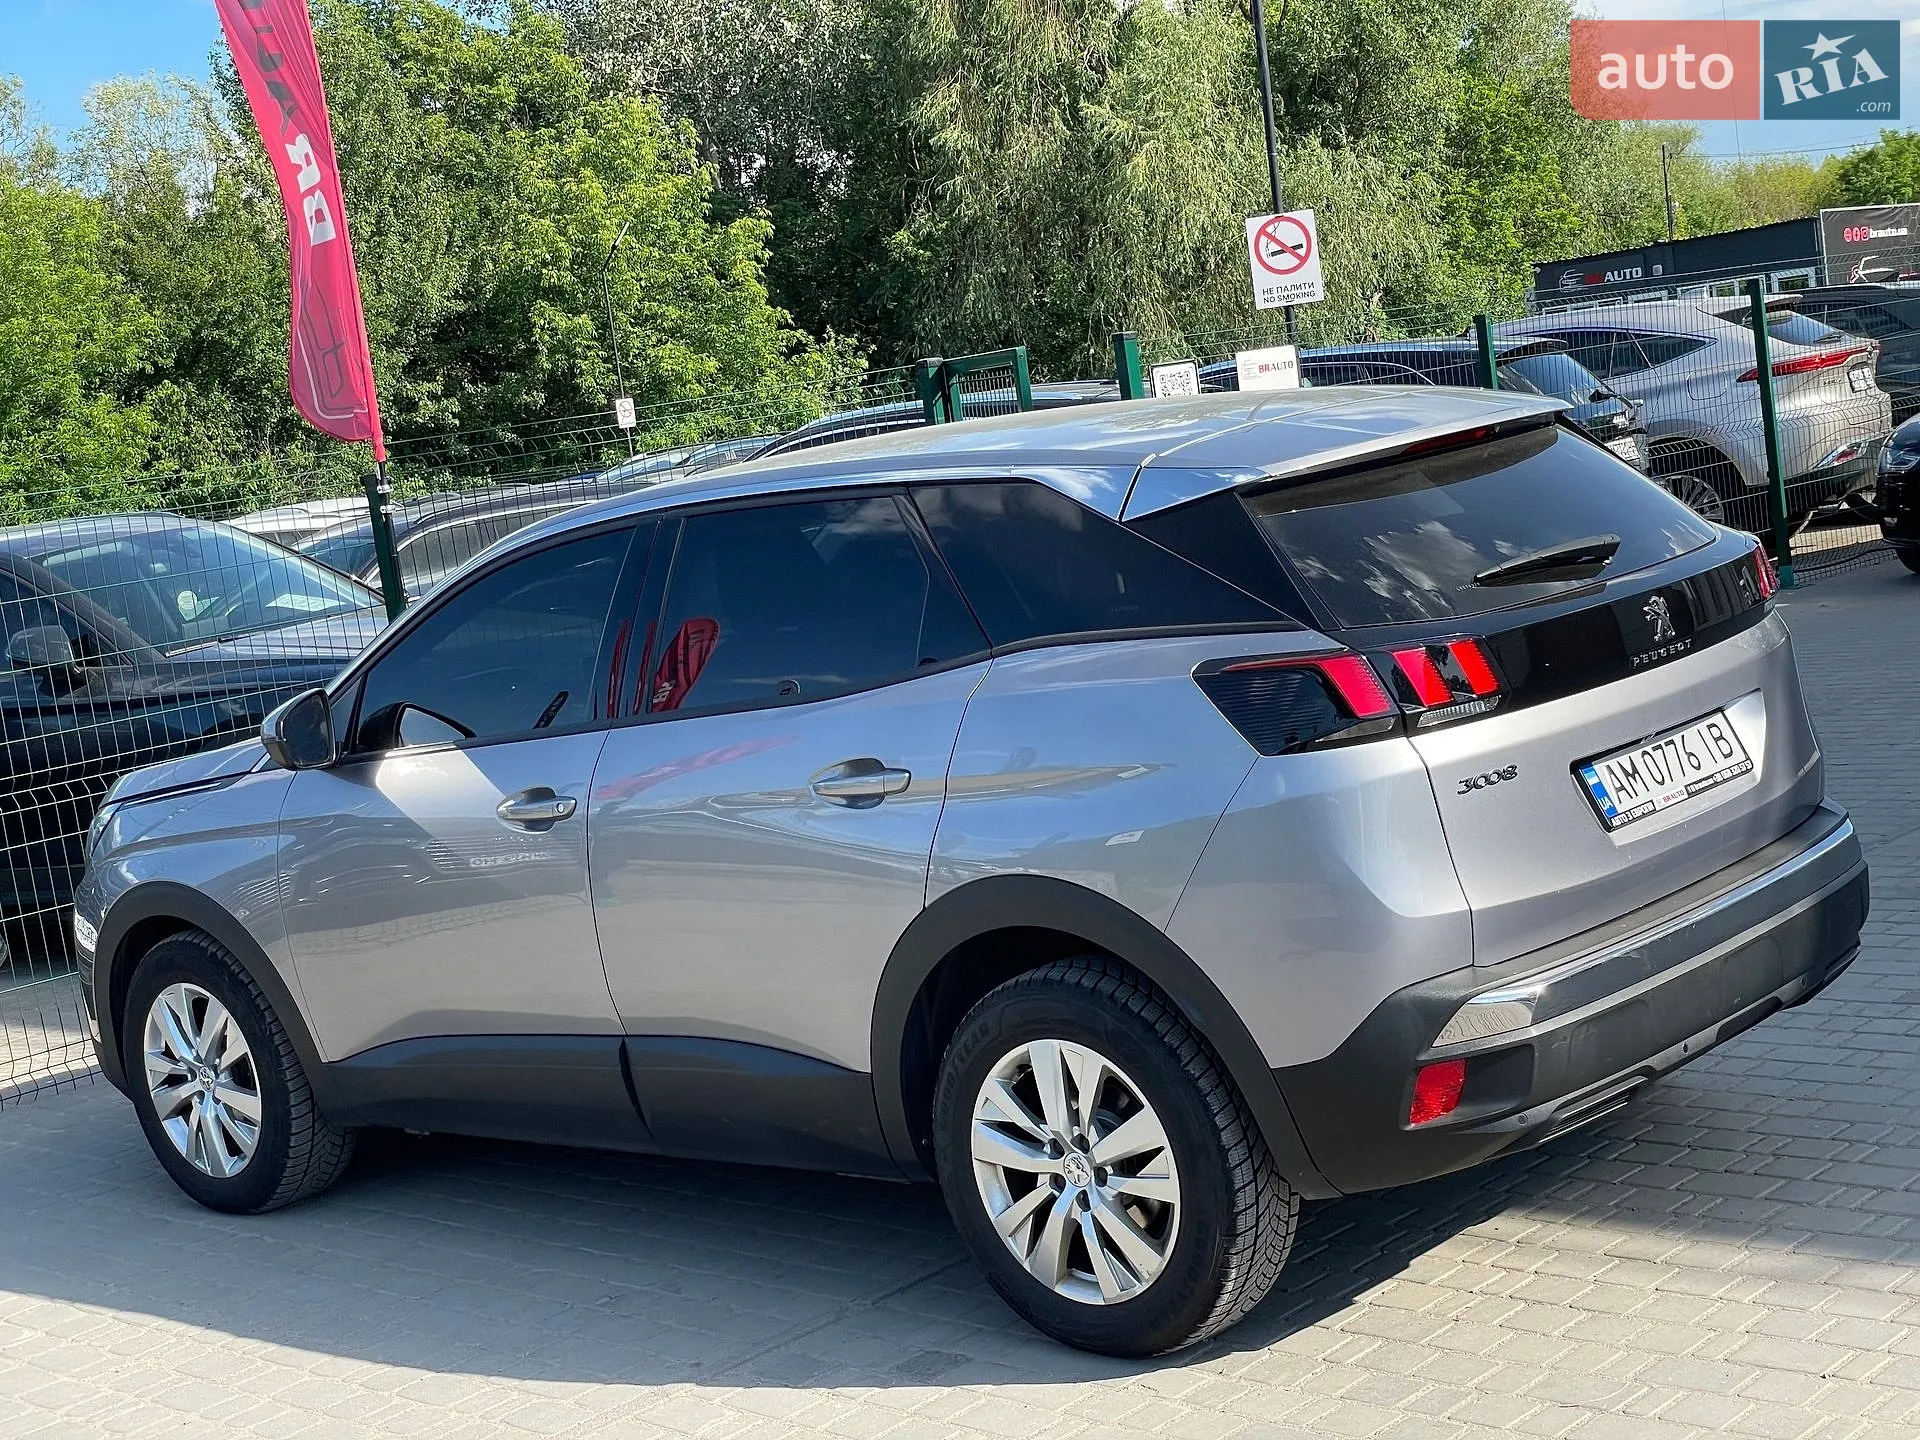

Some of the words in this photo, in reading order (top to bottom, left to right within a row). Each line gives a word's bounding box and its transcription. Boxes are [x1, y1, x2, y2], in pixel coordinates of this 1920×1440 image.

[1262, 287, 1275, 296] НЕ
[1276, 281, 1315, 294] ПАЛИТИ
[1263, 295, 1276, 304] NO
[1277, 290, 1316, 302] SMOKING
[1632, 638, 1692, 667] PEUGEOT
[1604, 755, 1650, 804] AM
[1641, 734, 1701, 786] 0776
[1697, 722, 1734, 764] IB
[1457, 764, 1518, 795] 3008
[1598, 798, 1614, 810] UA
